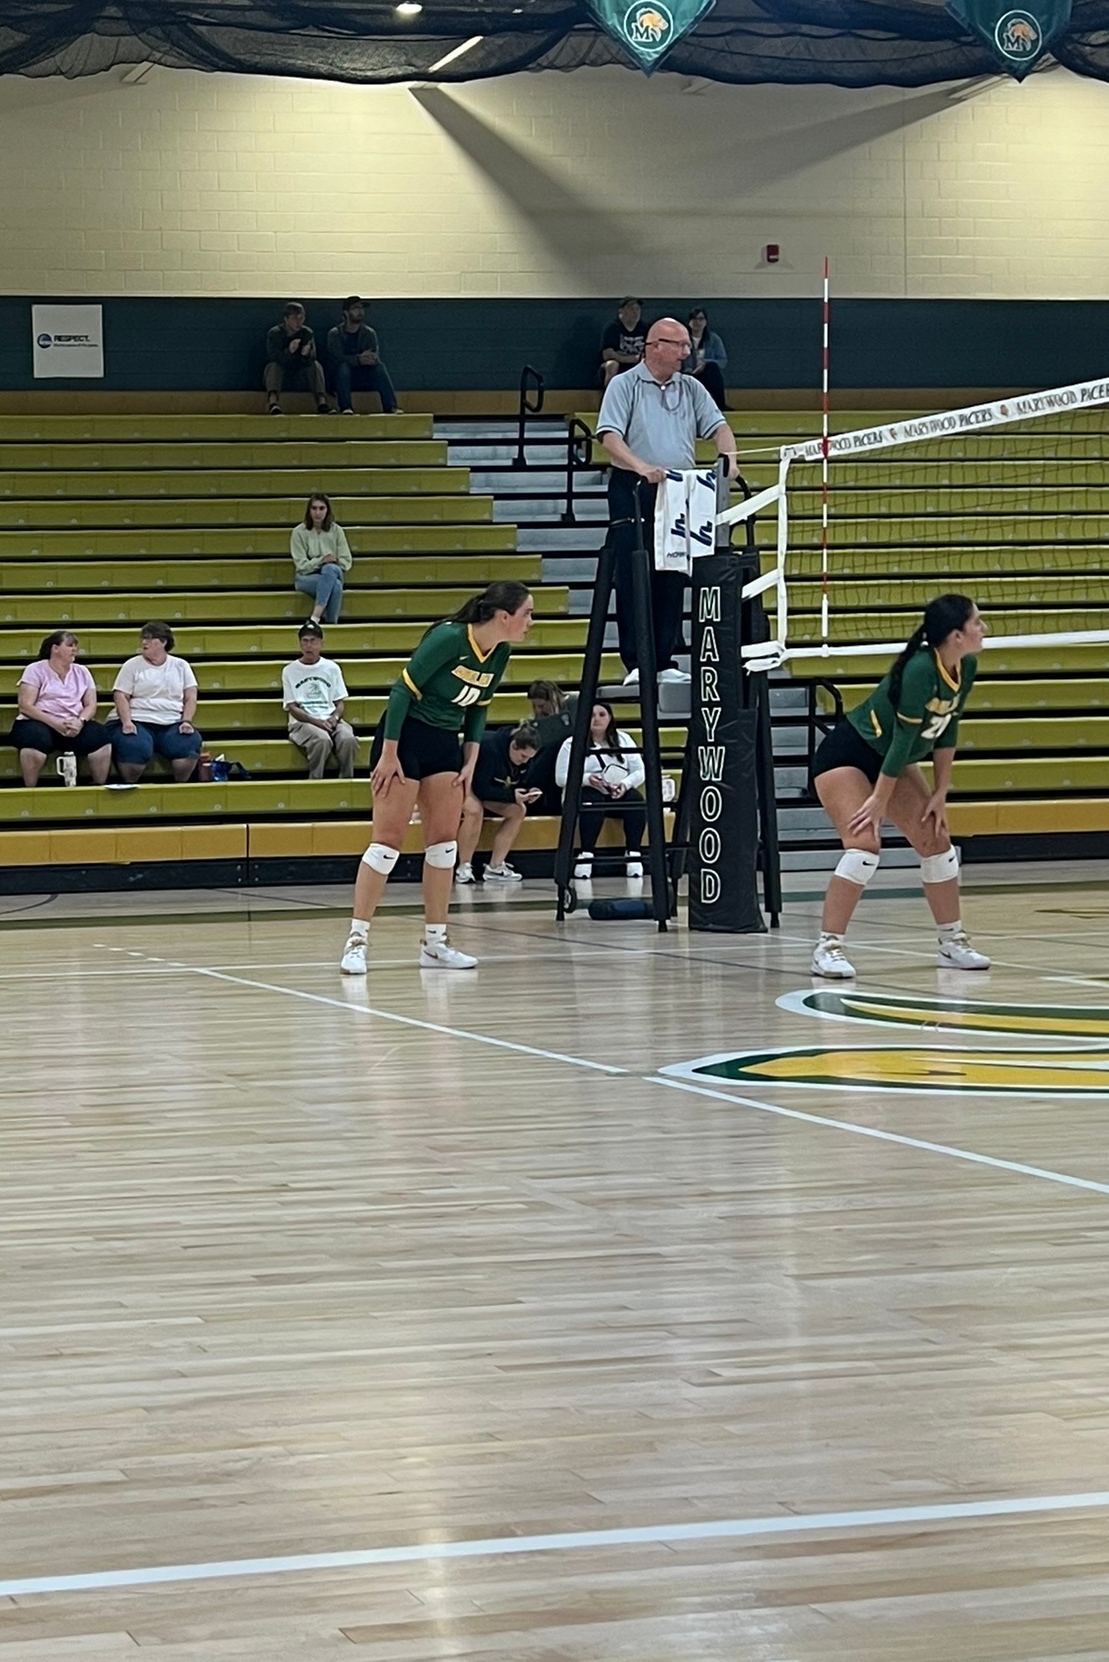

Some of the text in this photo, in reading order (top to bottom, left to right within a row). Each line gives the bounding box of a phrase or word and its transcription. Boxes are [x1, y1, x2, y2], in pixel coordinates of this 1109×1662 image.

[904, 416, 957, 437] MARYWOOD
[959, 408, 993, 427] PACERS
[1017, 391, 1078, 414] MARYWOOD
[698, 586, 726, 904] MARYWOOD
